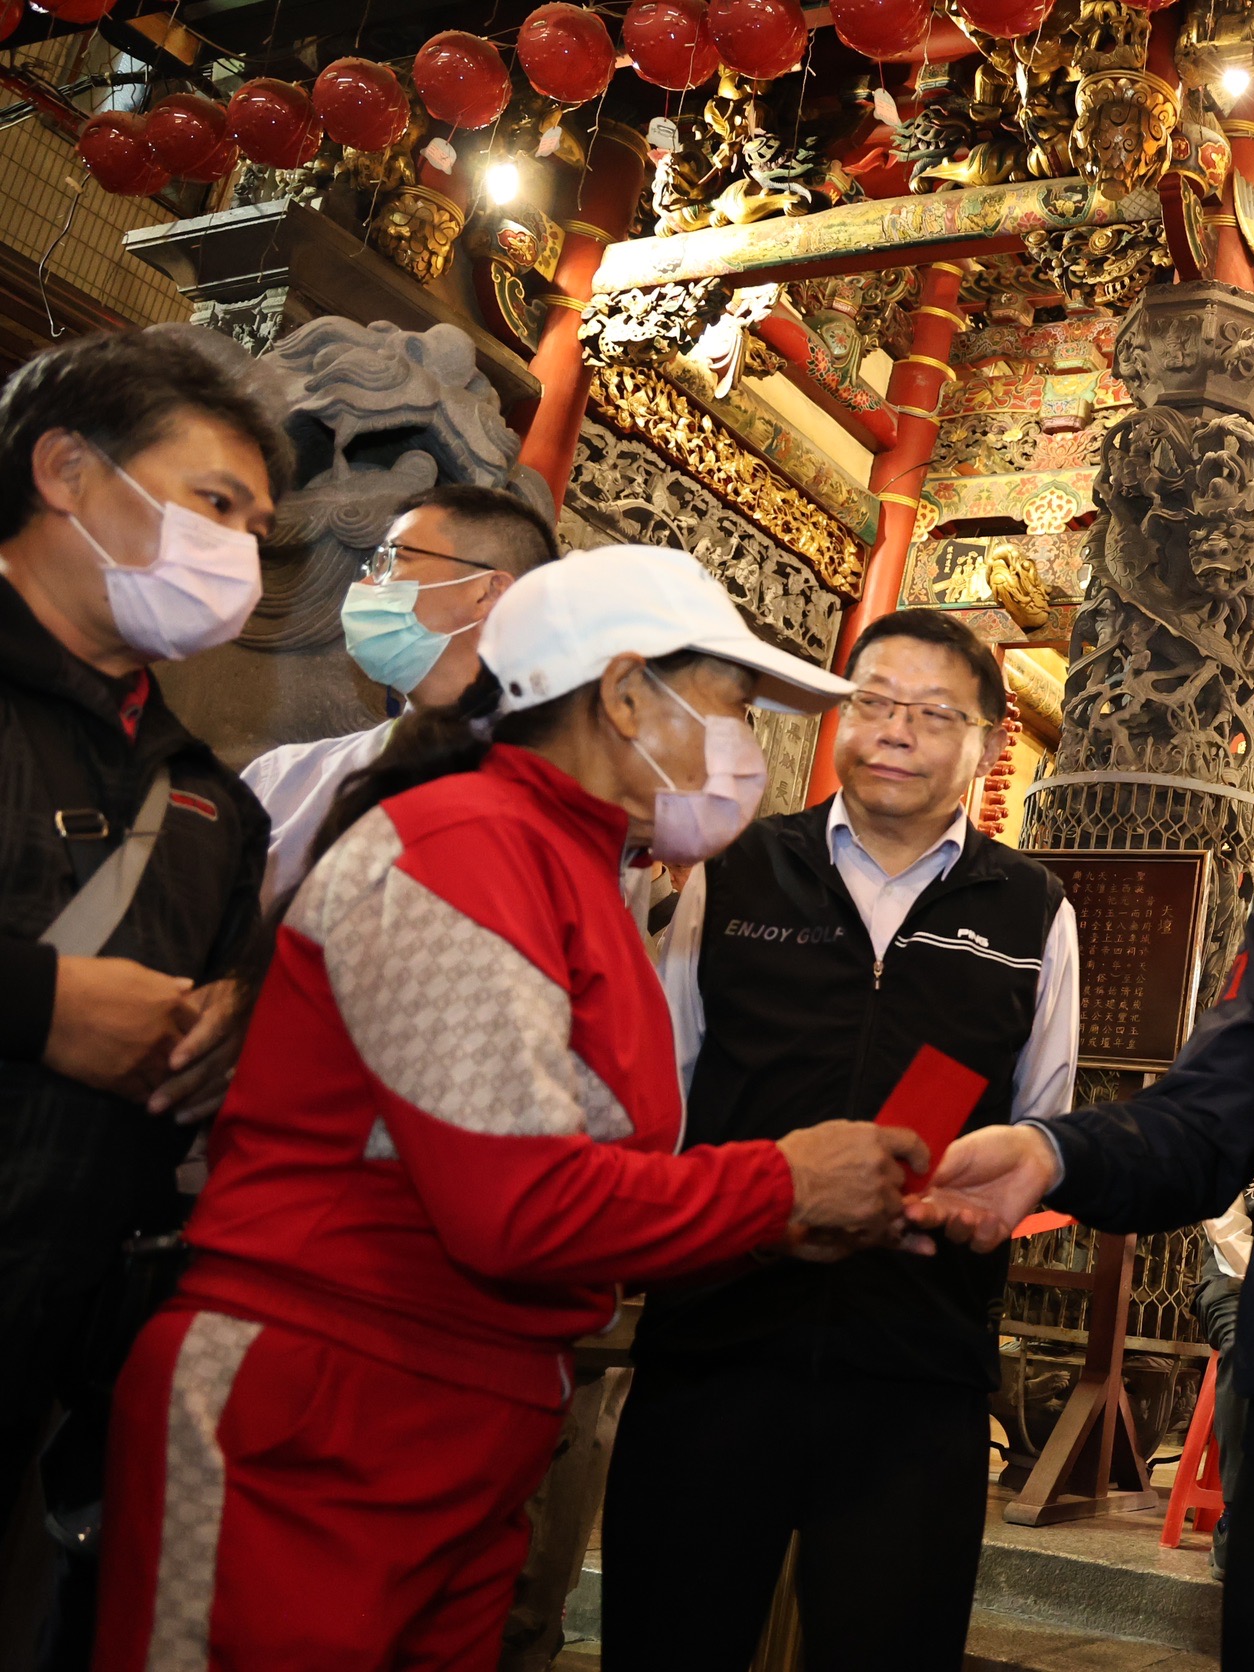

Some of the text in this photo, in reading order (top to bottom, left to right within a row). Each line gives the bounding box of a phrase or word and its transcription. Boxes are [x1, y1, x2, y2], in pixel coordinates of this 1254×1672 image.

[724, 919, 846, 945] ENJOY GOLF
[1157, 904, 1174, 935] 天壇
[957, 928, 989, 948] PING
